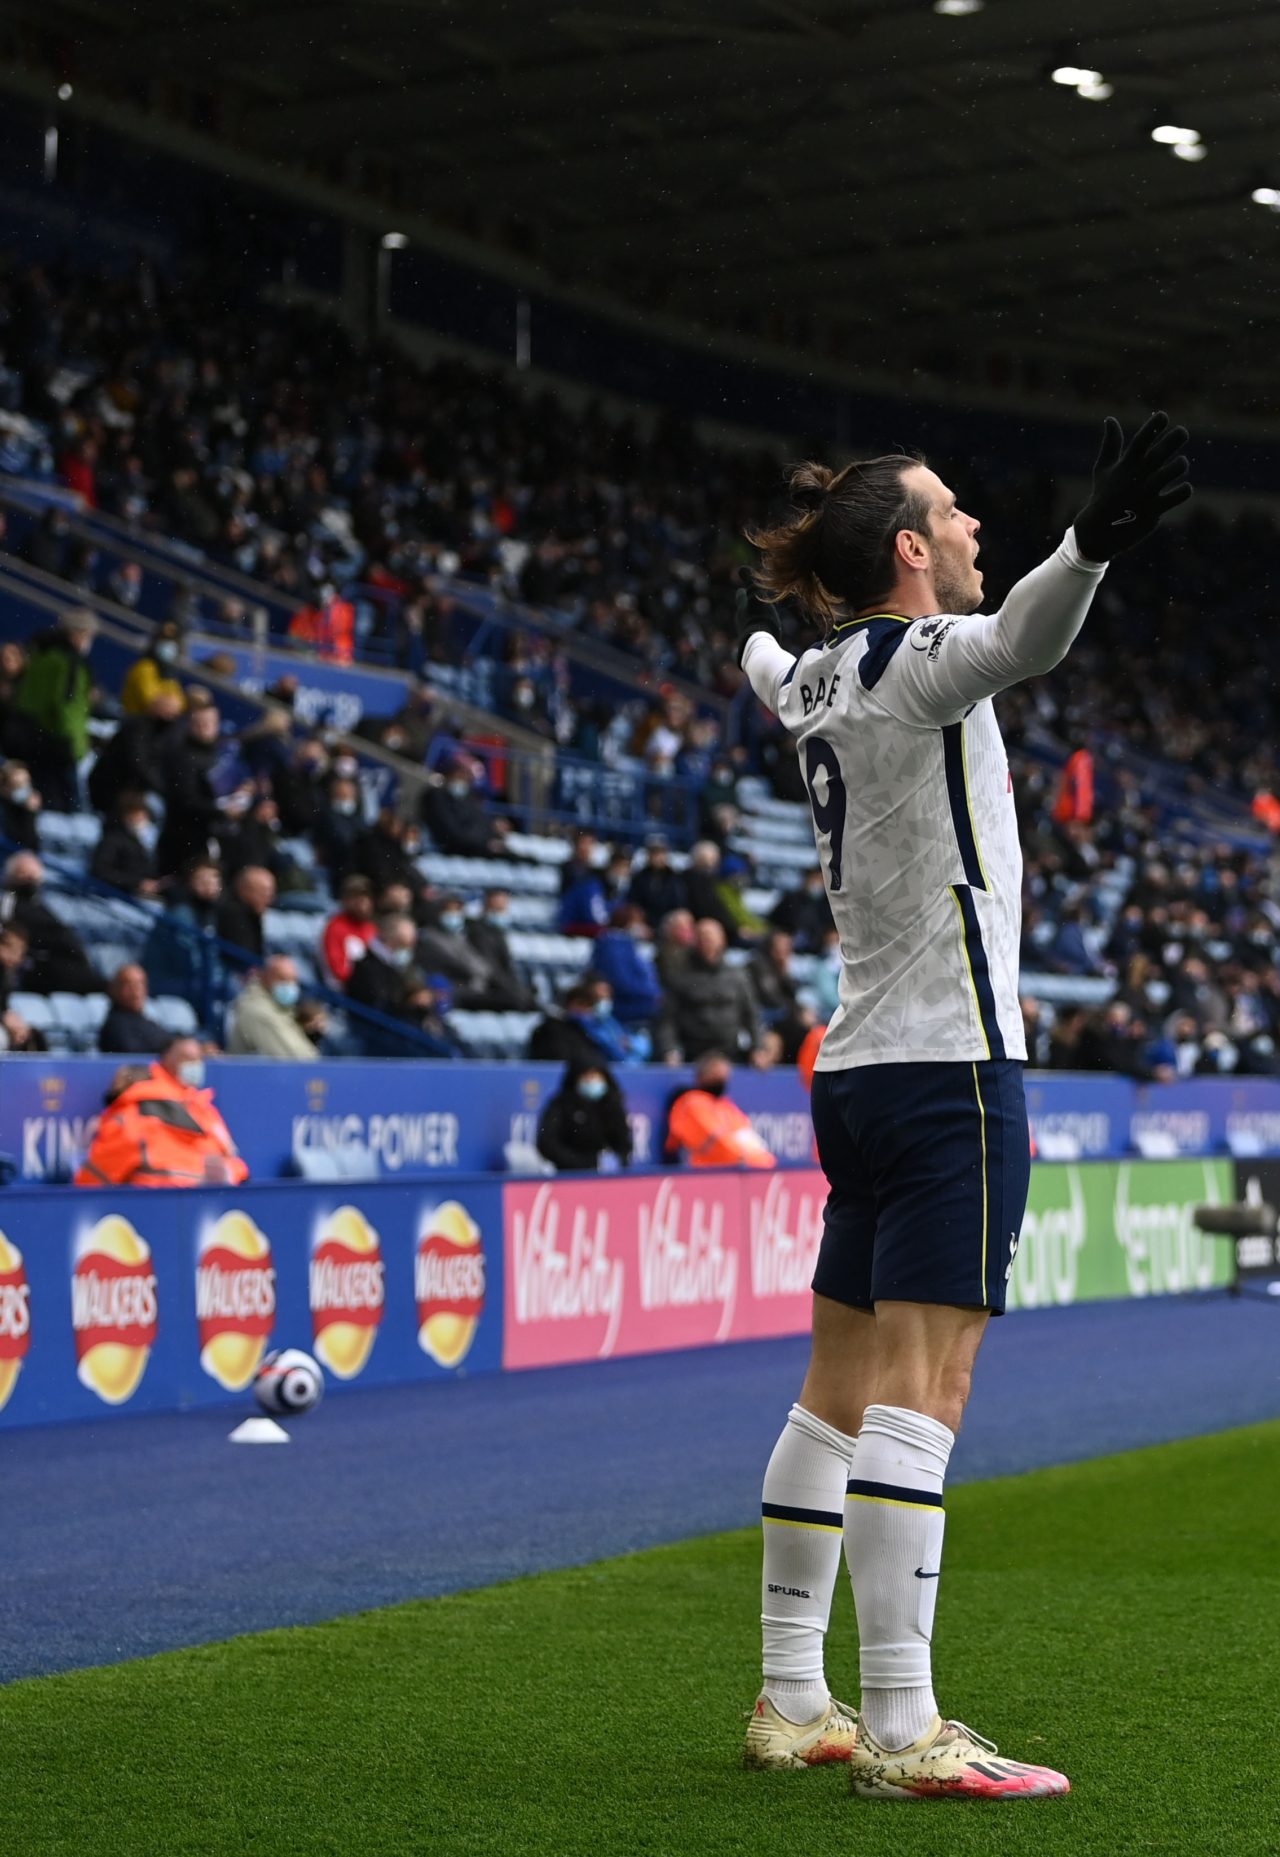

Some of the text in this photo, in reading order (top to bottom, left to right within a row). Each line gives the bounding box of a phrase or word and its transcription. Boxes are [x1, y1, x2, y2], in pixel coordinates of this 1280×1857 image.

[805, 736, 847, 891] 9
[368, 1111, 460, 1171] POWER
[513, 1182, 625, 1361] Vitality
[638, 1176, 739, 1344] Vitality
[768, 1583, 810, 1599] SPURS
